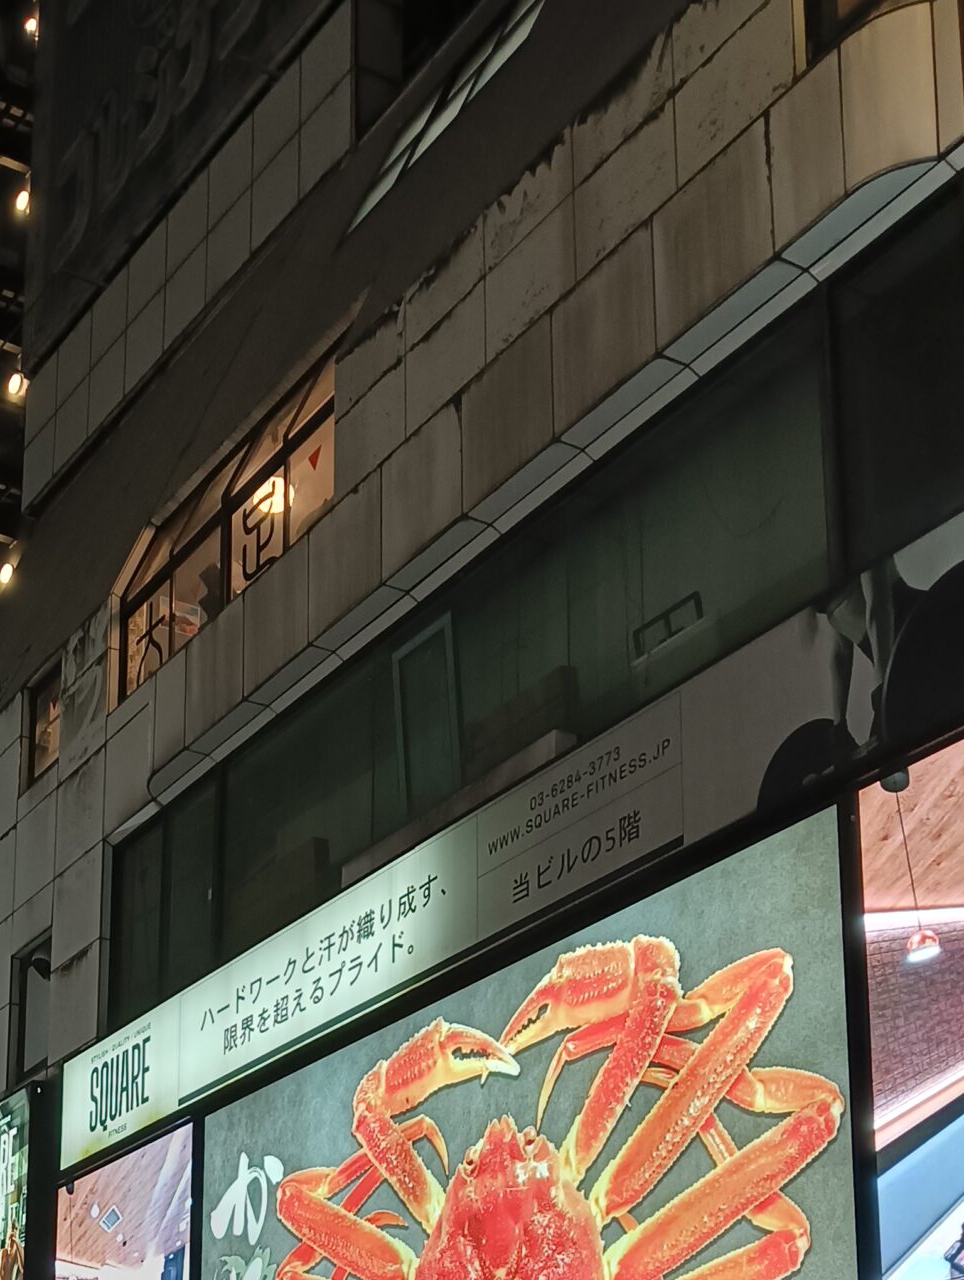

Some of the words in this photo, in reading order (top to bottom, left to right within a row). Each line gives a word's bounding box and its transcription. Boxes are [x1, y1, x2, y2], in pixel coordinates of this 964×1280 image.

[487, 738, 671, 856] WWW.SQUARE-FITNESS.JP
[529, 746, 621, 811] 03-6284-3773
[512, 810, 642, 904] 当ビルの5階
[200, 874, 447, 1031] ハードワークと汗が織り成す、
[223, 931, 414, 1055] 限界を超えるプライド。
[89, 1035, 151, 1132] SQUARE
[108, 1122, 128, 1138] FITNESS
